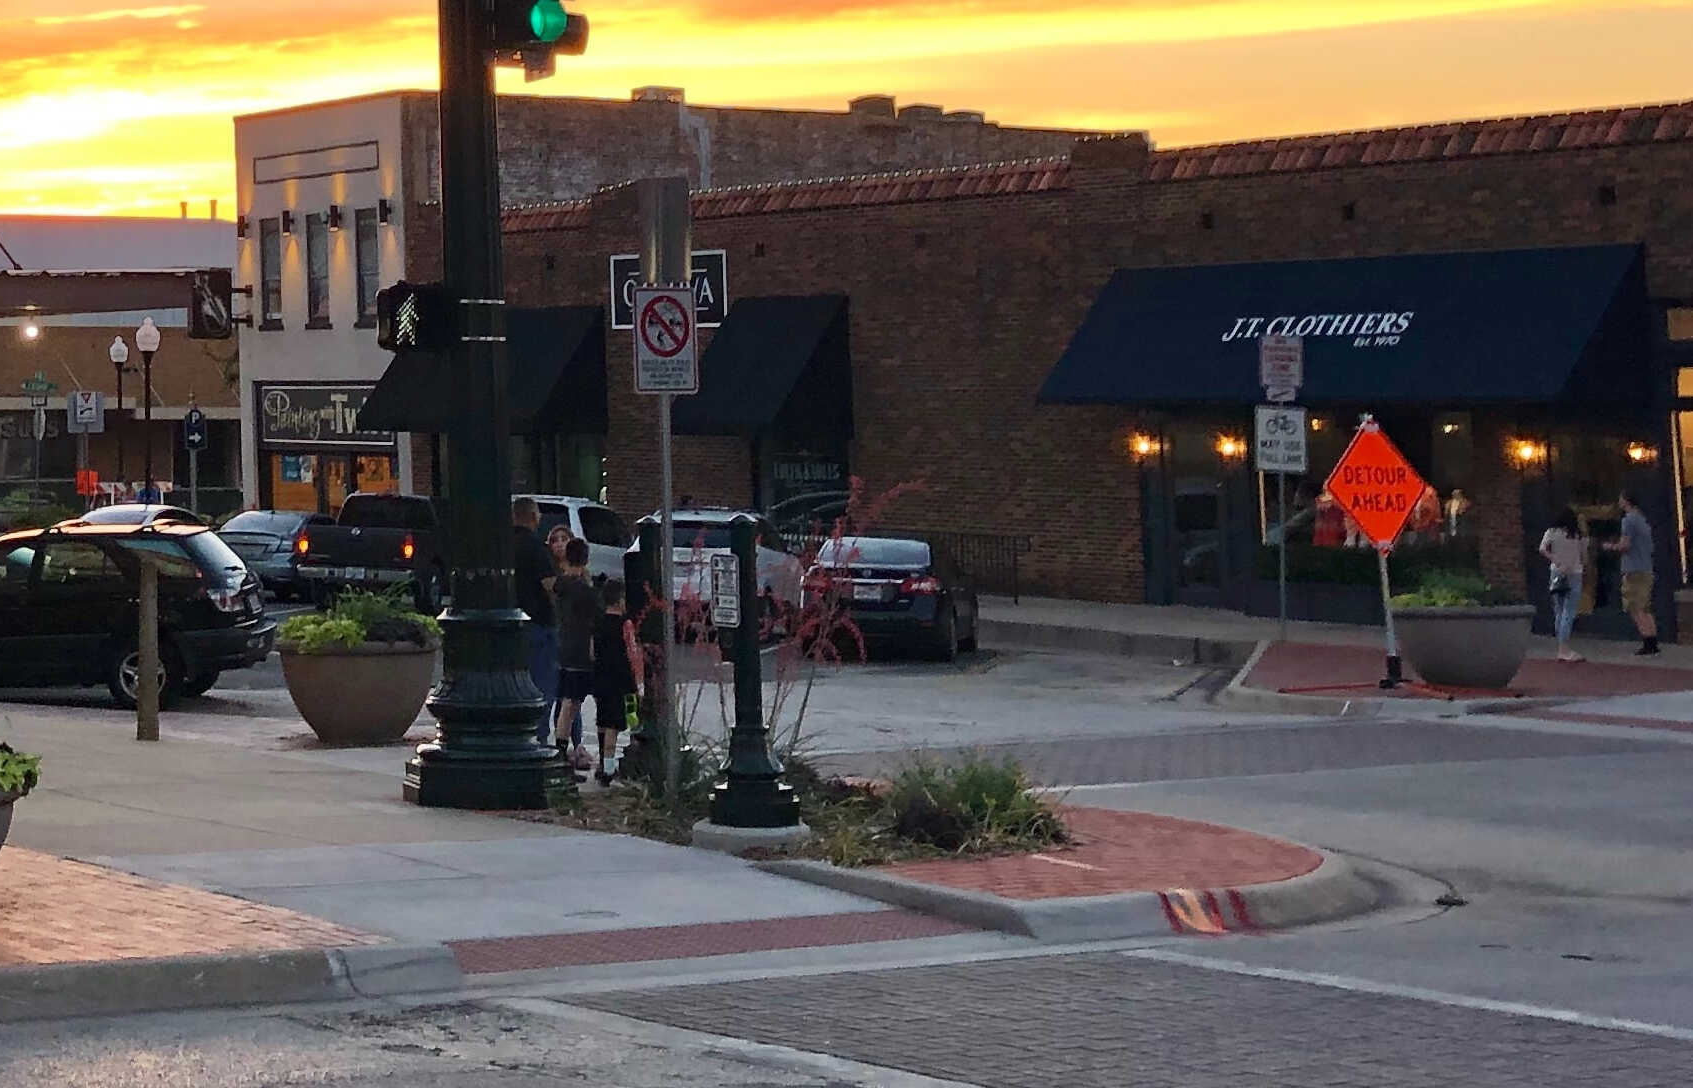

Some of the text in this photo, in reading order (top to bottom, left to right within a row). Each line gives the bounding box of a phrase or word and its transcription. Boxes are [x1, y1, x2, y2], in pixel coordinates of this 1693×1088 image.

[1221, 311, 1415, 343] J.T. CLOTHIERS
[190, 411, 201, 424] P
[1342, 465, 1407, 485] DETOUR
[1351, 493, 1407, 513] AHEAD
